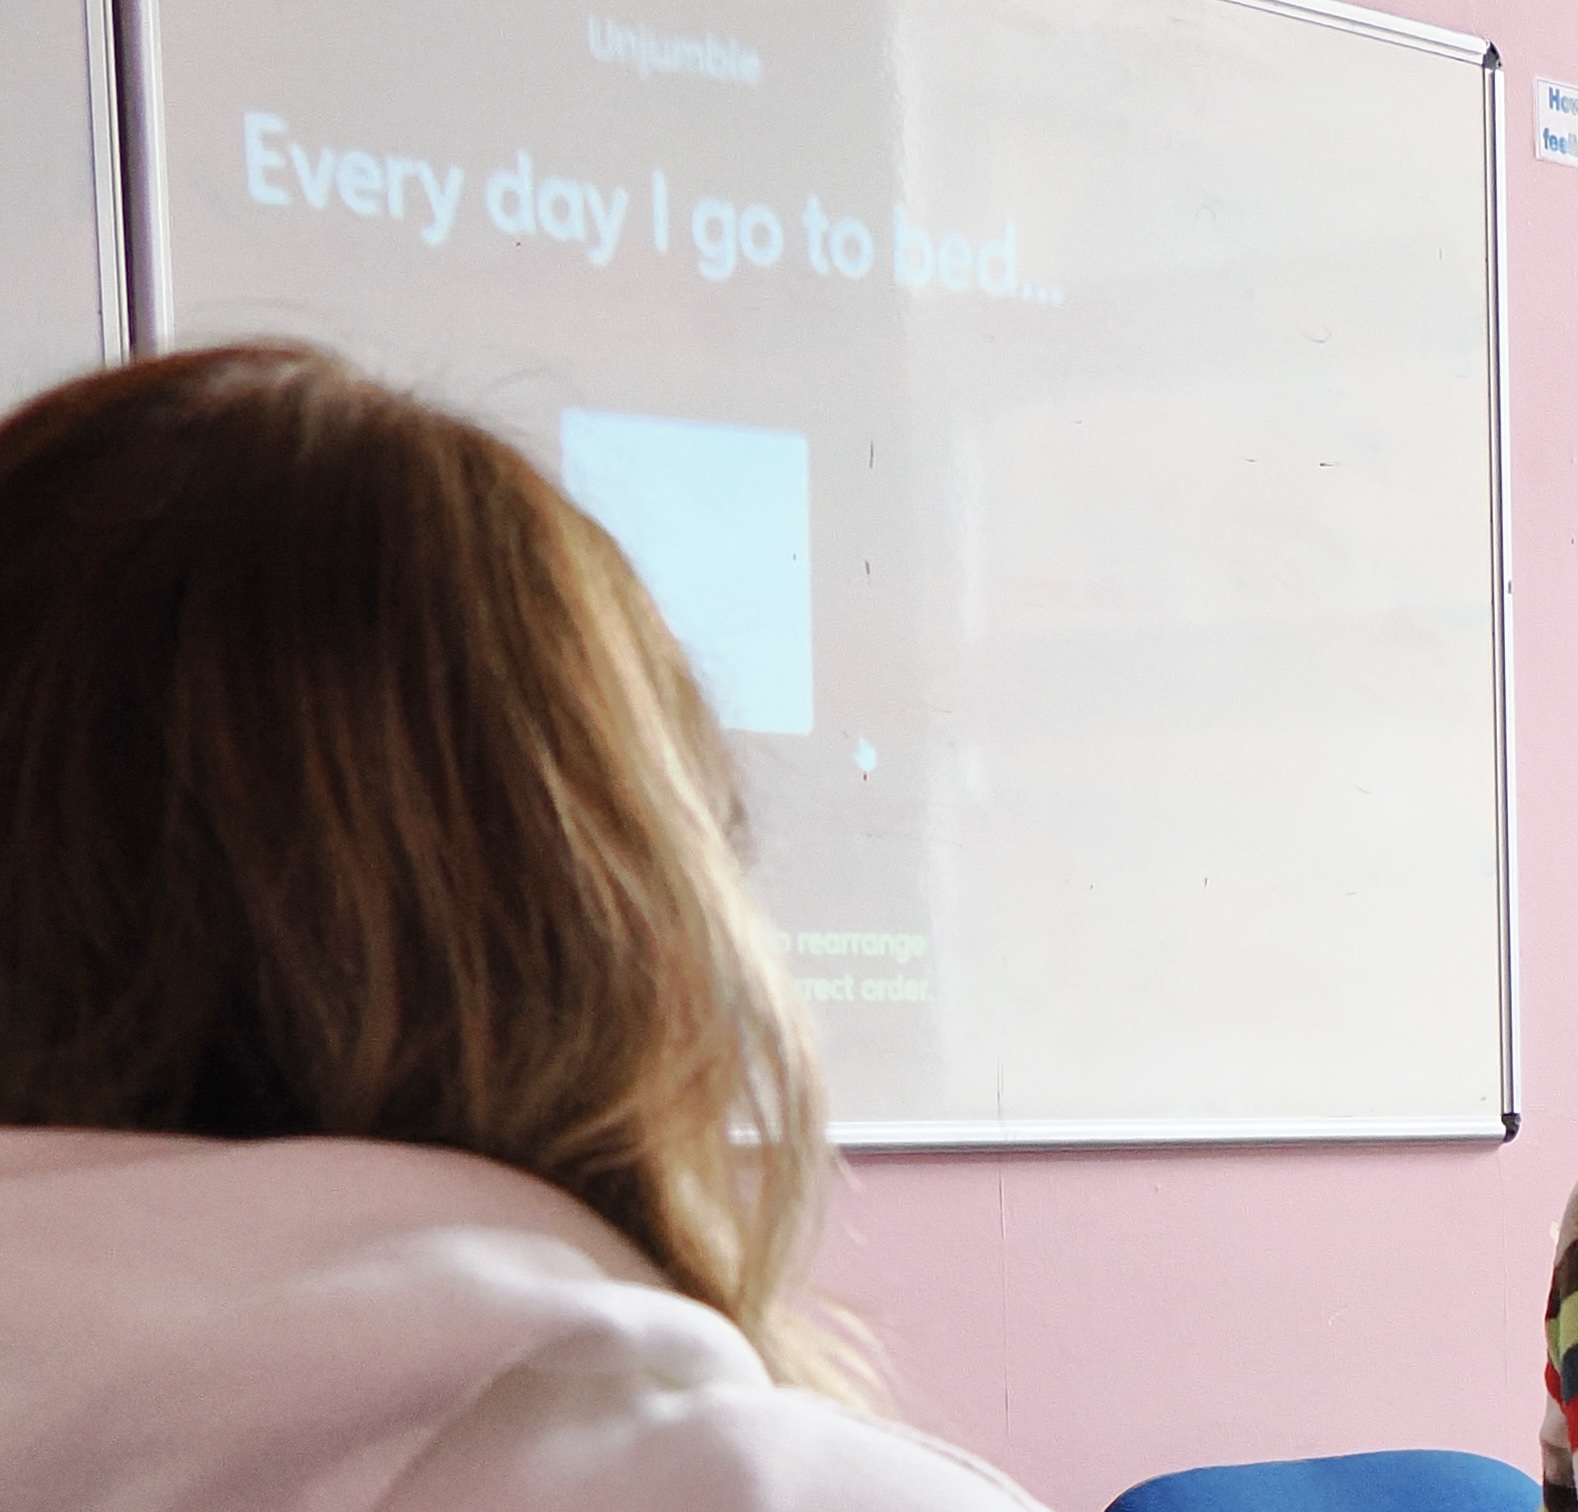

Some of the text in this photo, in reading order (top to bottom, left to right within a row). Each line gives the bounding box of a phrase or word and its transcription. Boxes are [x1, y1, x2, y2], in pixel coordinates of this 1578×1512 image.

[588, 13, 763, 86] Unjumble
[242, 111, 1063, 304] Every day I go to bed...
[797, 931, 926, 964] rearrange
